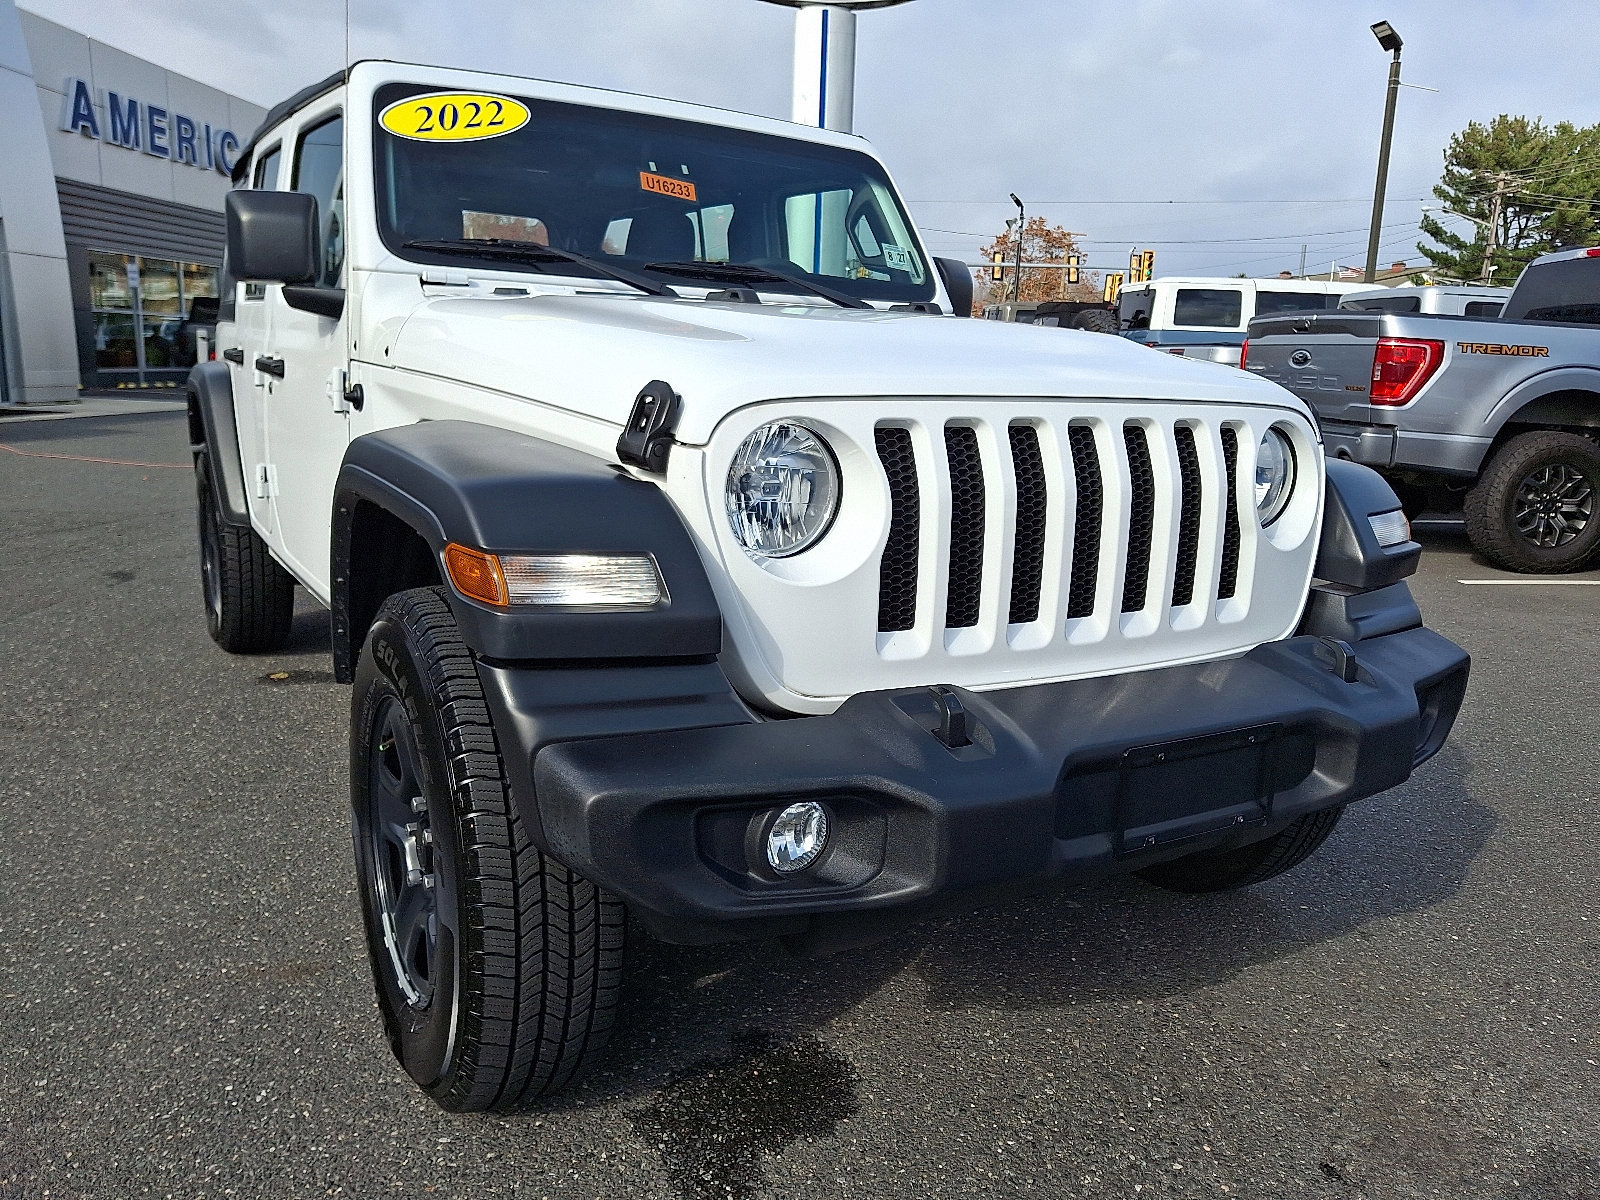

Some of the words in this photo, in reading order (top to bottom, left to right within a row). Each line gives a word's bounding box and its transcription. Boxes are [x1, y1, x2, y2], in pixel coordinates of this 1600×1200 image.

[414, 100, 506, 133] 2022
[646, 176, 691, 197] U16233
[1457, 341, 1550, 357] TREMOR
